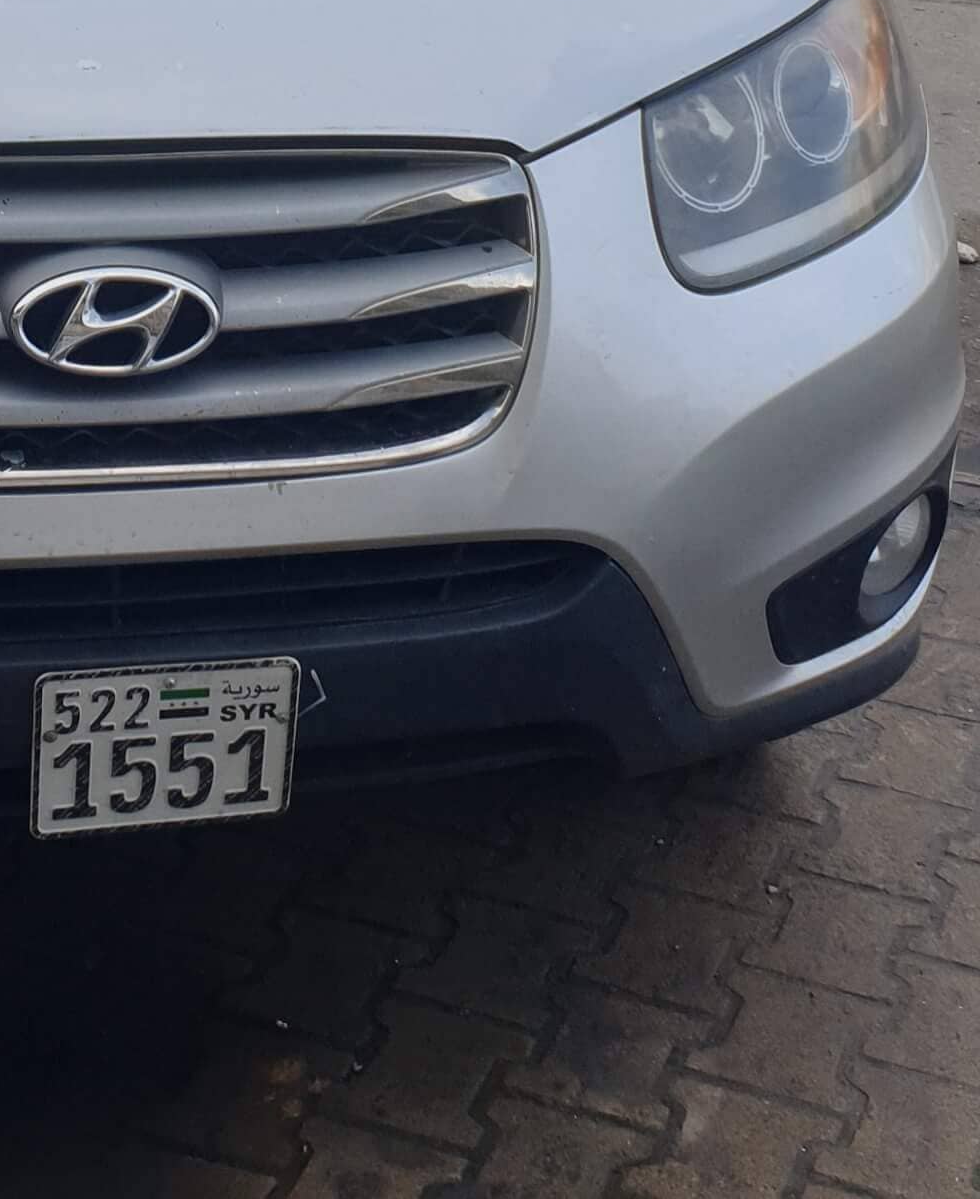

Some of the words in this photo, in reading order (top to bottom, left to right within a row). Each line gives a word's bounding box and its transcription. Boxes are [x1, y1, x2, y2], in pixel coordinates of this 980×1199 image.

[221, 680, 281, 699] سورية
[53, 686, 151, 735] 522
[220, 703, 278, 722] SYR
[51, 728, 270, 821] 1551
